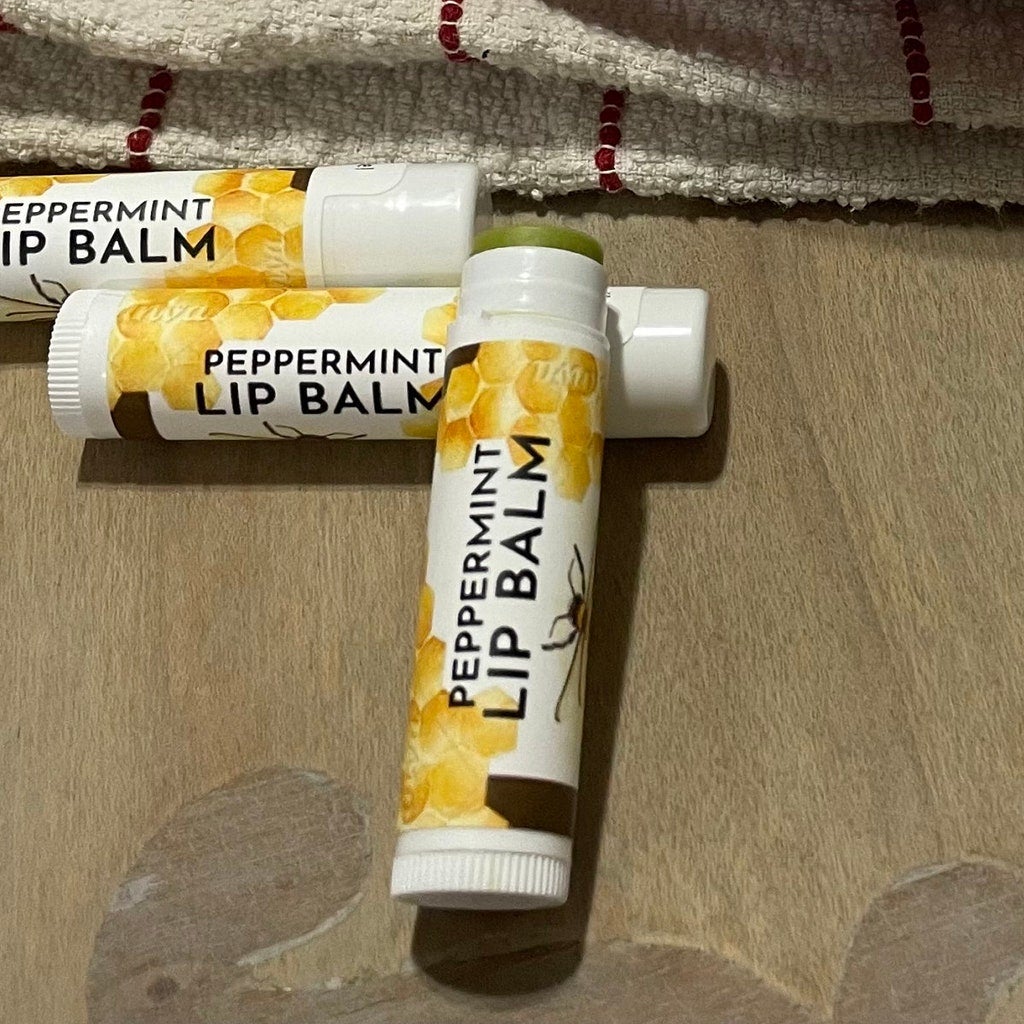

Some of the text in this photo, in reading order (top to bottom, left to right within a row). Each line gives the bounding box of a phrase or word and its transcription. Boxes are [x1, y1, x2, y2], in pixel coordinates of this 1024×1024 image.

[2, 198, 212, 224] EPPERMINT
[2, 226, 216, 266] IP BALM
[204, 348, 442, 376] PEPPERMINT
[195, 381, 445, 416] LIP BALM
[449, 444, 502, 708] PEPPERMINT
[482, 435, 551, 720] LIP BALM
